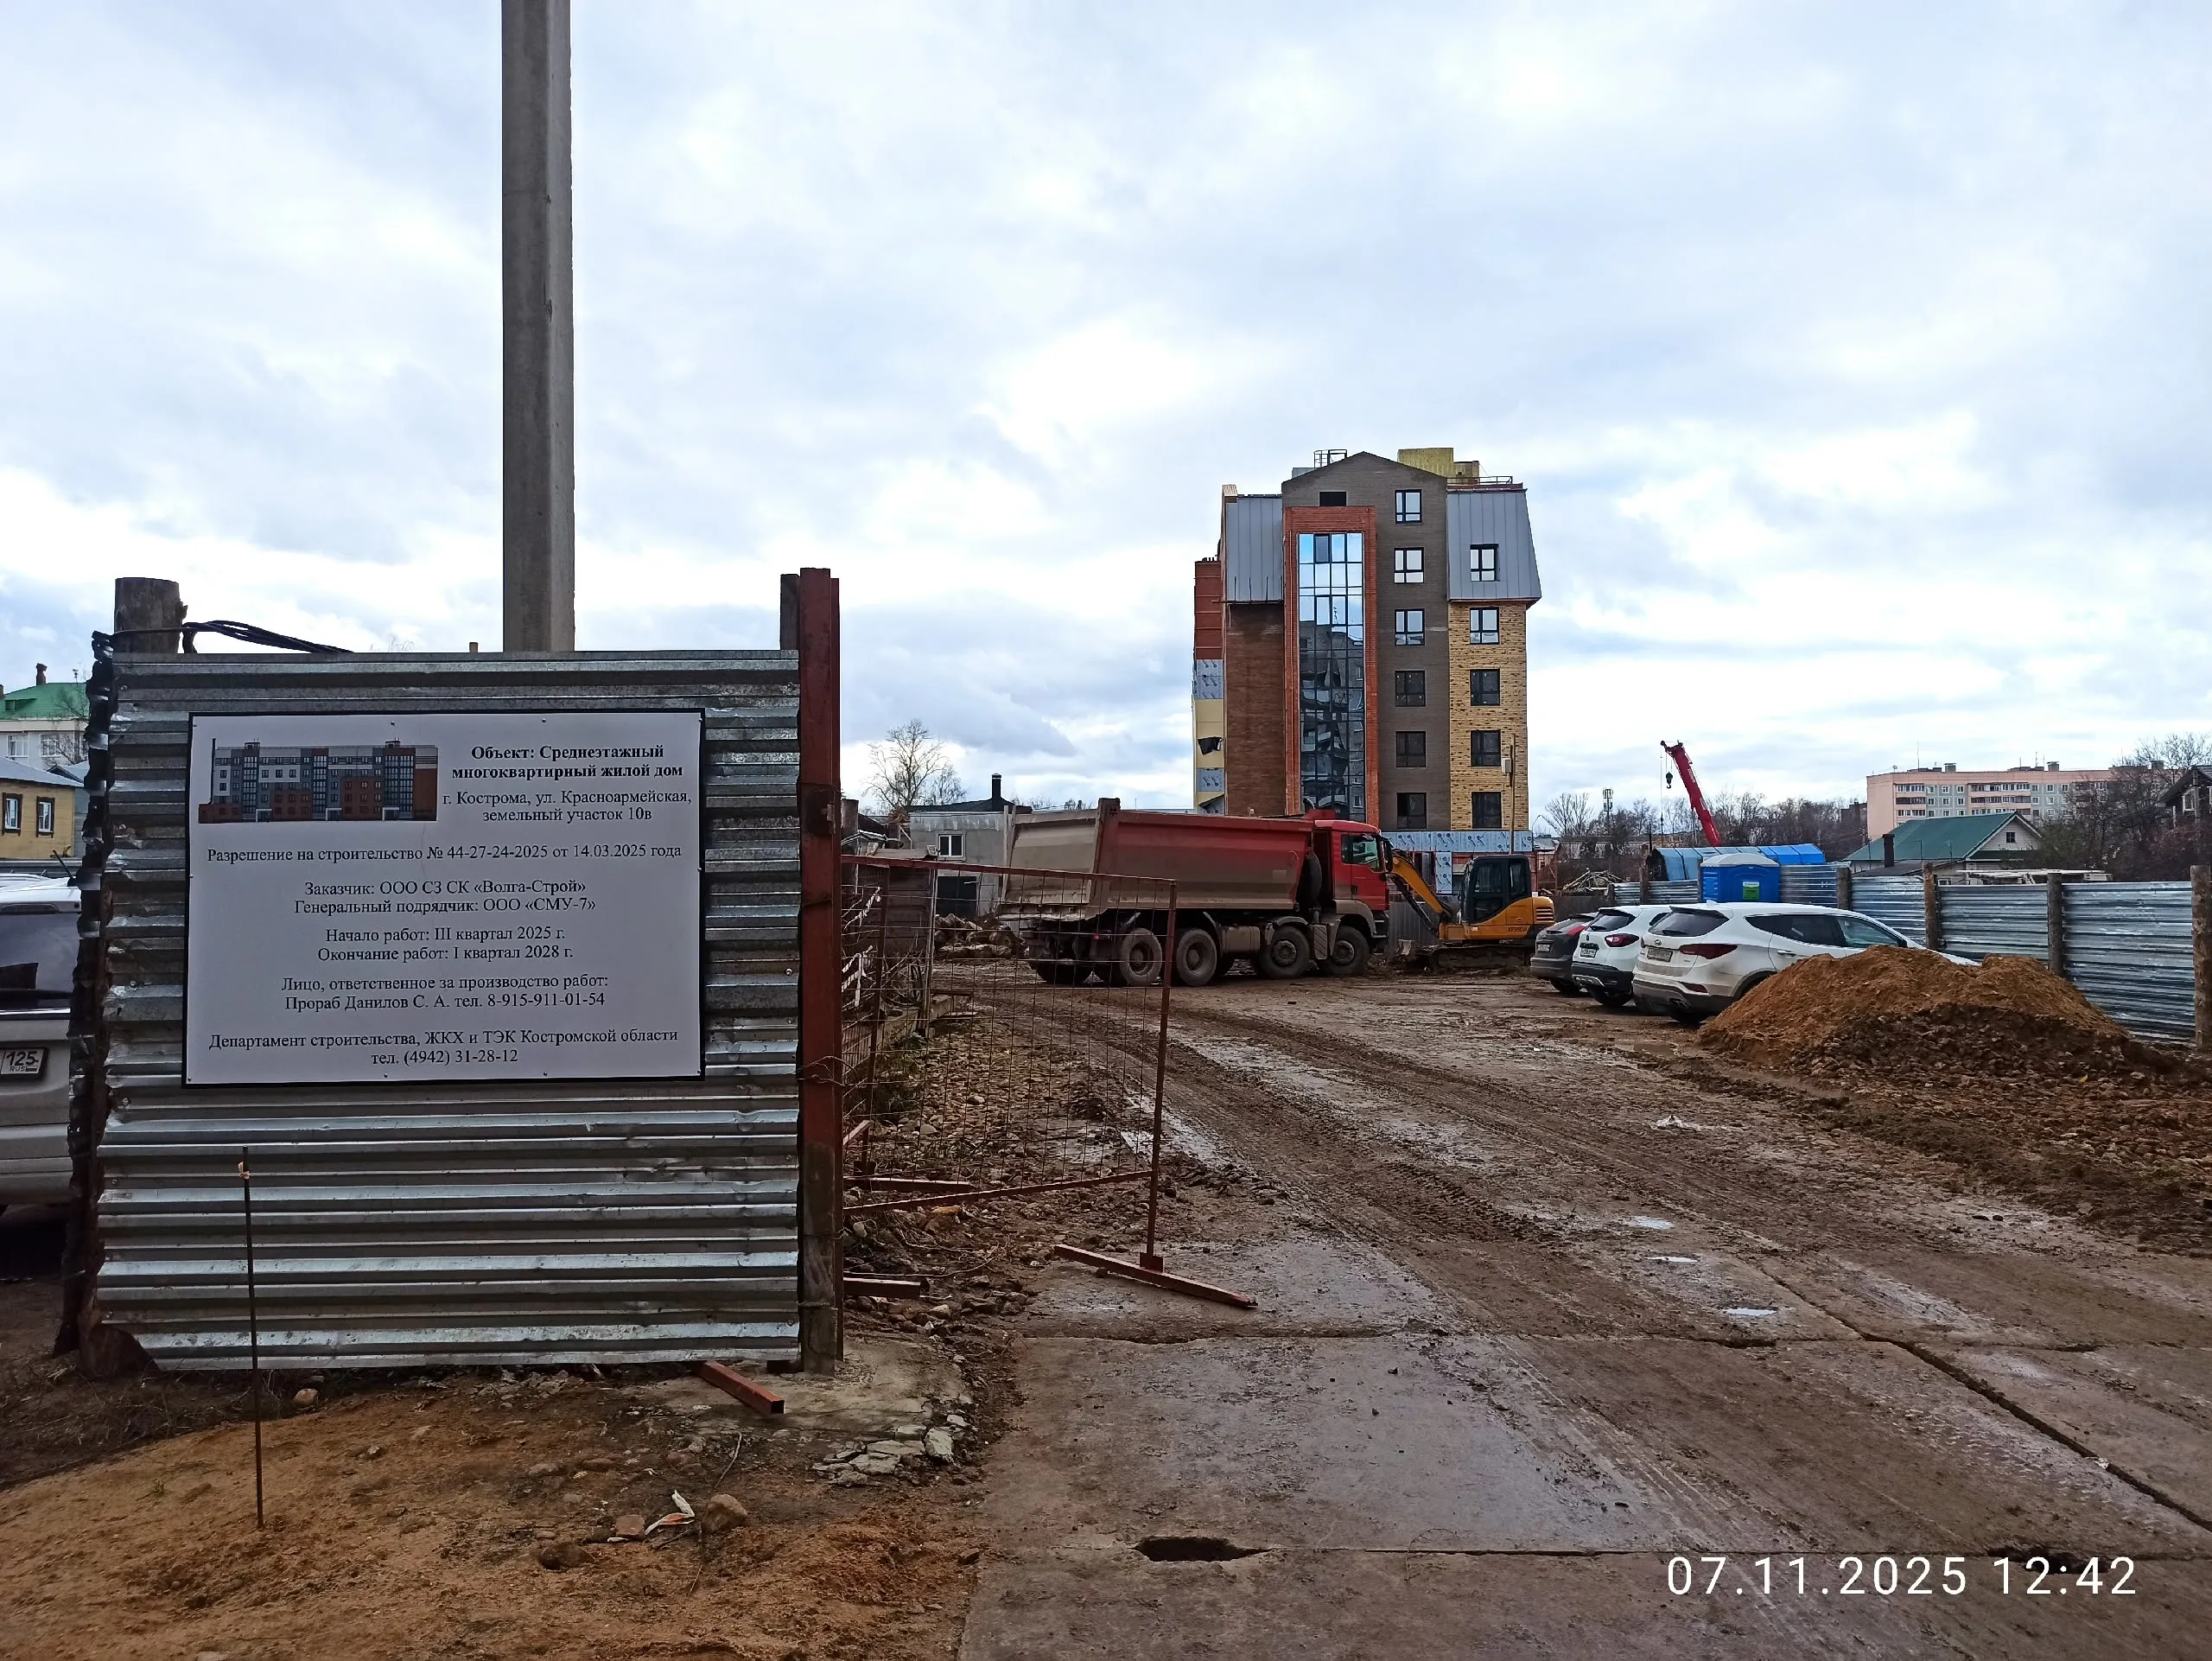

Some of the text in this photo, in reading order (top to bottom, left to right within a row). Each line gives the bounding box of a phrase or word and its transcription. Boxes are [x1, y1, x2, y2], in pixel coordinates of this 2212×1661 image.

[471, 744, 664, 762] Объект: Среднеэтажный
[452, 763, 683, 781] многоквартирный жилой дом
[442, 789, 692, 808] г. Кострома, ул. Красноармейская,
[482, 806, 652, 824] земельный участок 10в
[207, 843, 682, 865] Разрешение на строительство № 44-27-24-2025 от 14.03.2025 года
[304, 879, 586, 896] Заказчик: ООО СЗ СК «Волга-Строй»
[294, 897, 596, 917] Генеральный подрядчик: ООО «СМУ-7»
[325, 926, 565, 945] Начало работ: III квартал 2025 г.
[317, 945, 574, 964] Окончание работ: I квартал 2028 г.
[281, 973, 608, 993] Лицо, ответственное за производство работ:
[285, 992, 606, 1014] Прораб Данилов С. А. тел. 8-915-911-01-54
[208, 1028, 678, 1051] Департамент строительства, ЖКХ и ТЭК Костромской области
[6, 1050, 38, 1066] 125
[371, 1049, 518, 1067] тел. (4942) 31-28-12
